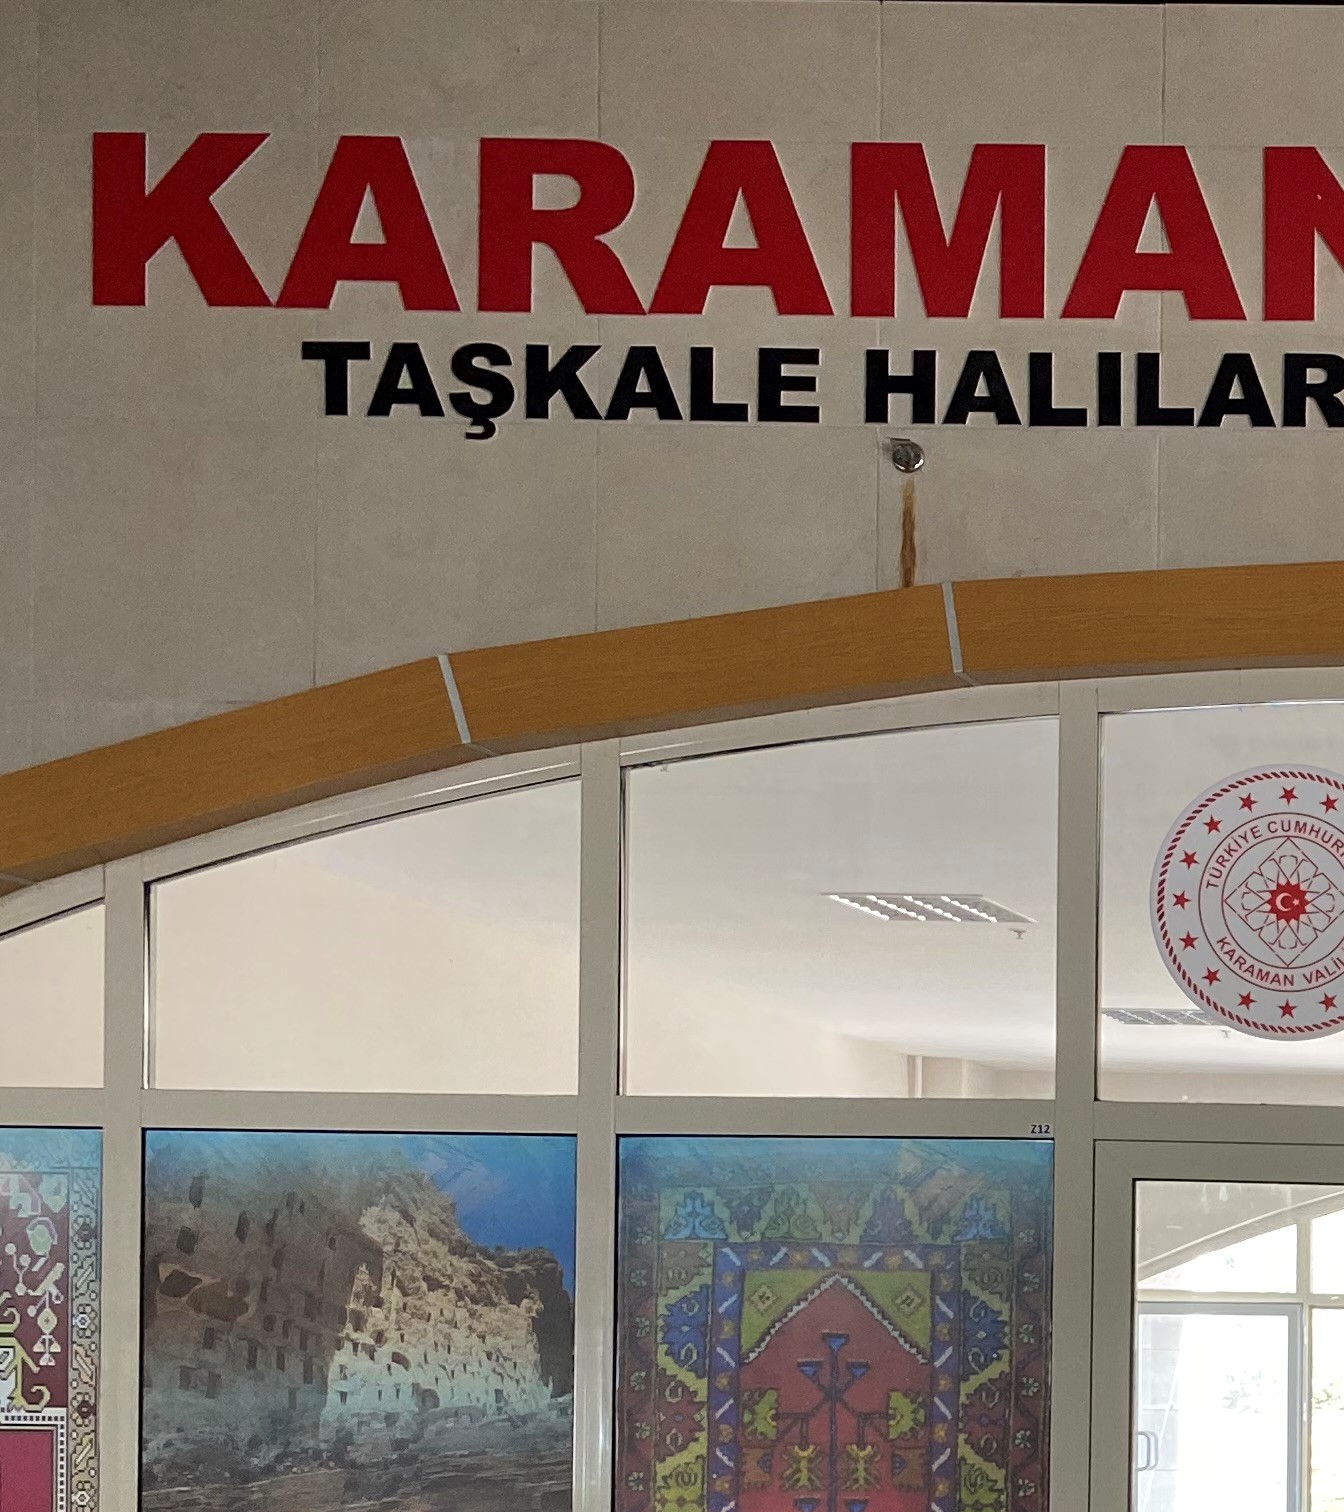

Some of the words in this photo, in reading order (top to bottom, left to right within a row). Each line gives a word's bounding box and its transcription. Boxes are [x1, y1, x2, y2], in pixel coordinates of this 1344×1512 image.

[301, 340, 820, 440] TAŞKALE
[1205, 825, 1263, 890] TÜRKİYE
[1216, 936, 1295, 987] KARAMAN
[1030, 1124, 1051, 1134] Z12
